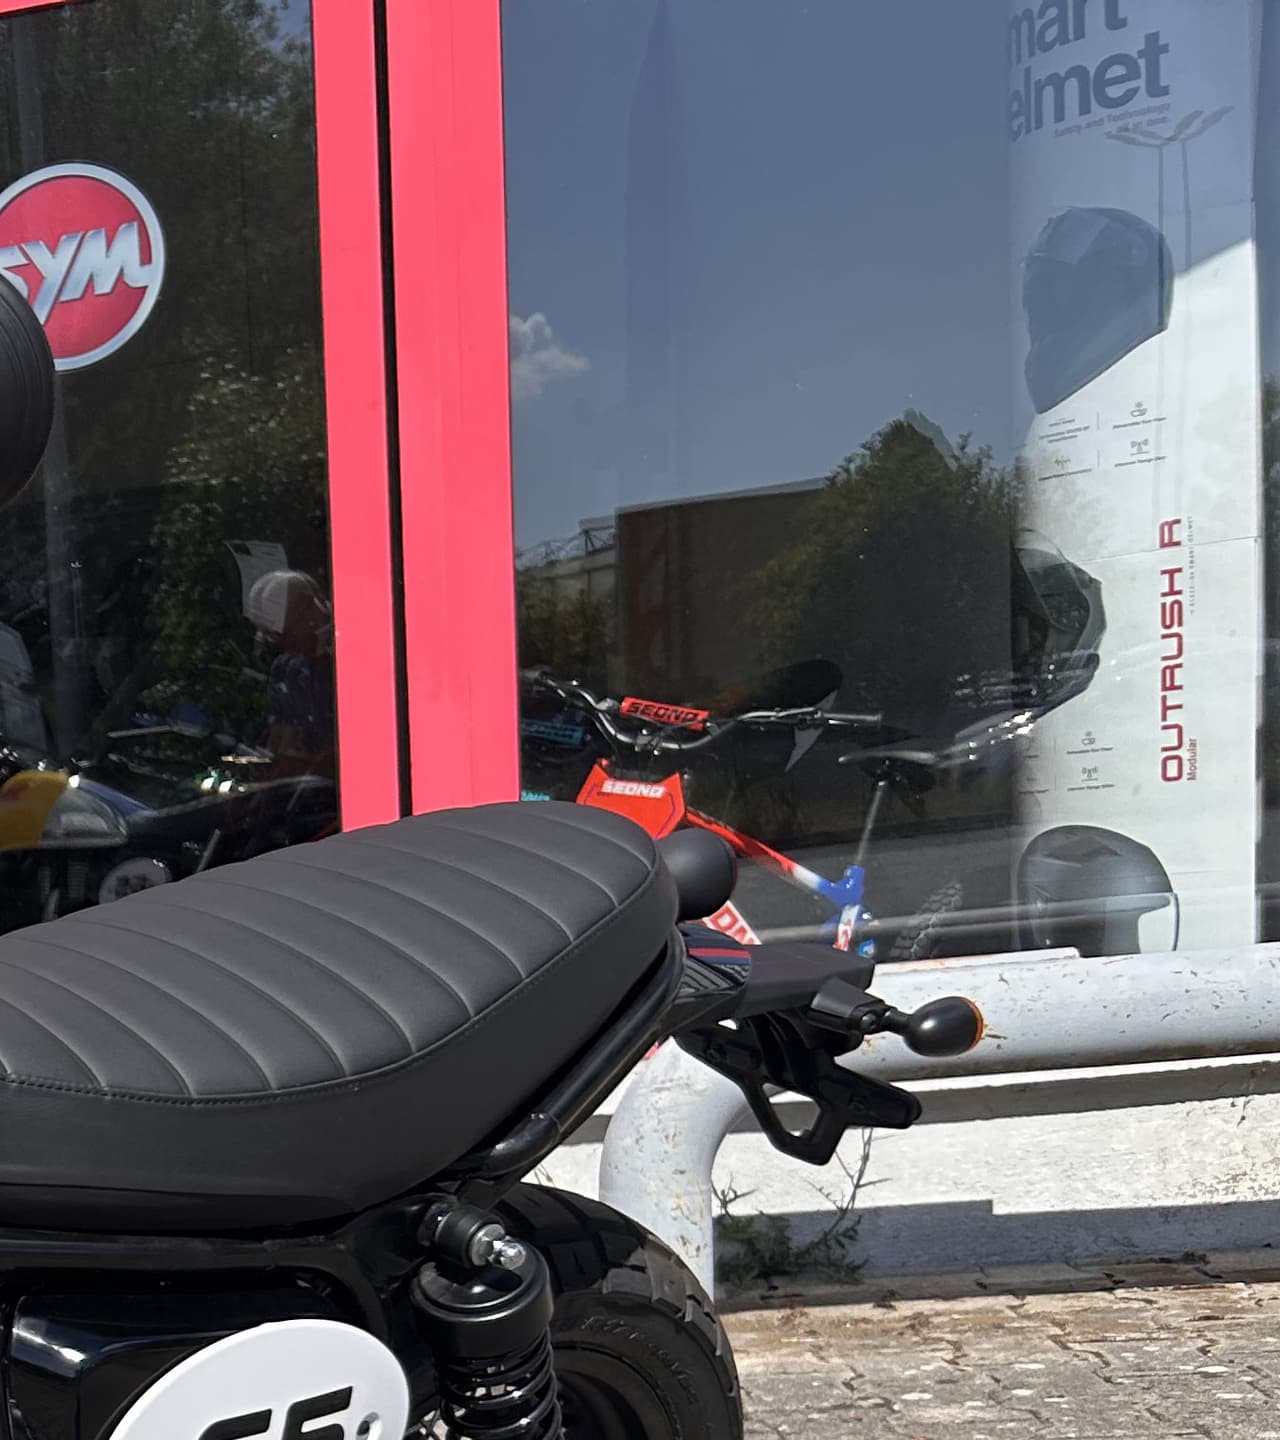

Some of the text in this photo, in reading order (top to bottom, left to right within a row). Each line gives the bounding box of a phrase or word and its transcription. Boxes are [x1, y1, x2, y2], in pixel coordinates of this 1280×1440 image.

[1159, 518, 1184, 782] OUTRUSH R
[1186, 738, 1197, 780] Modular
